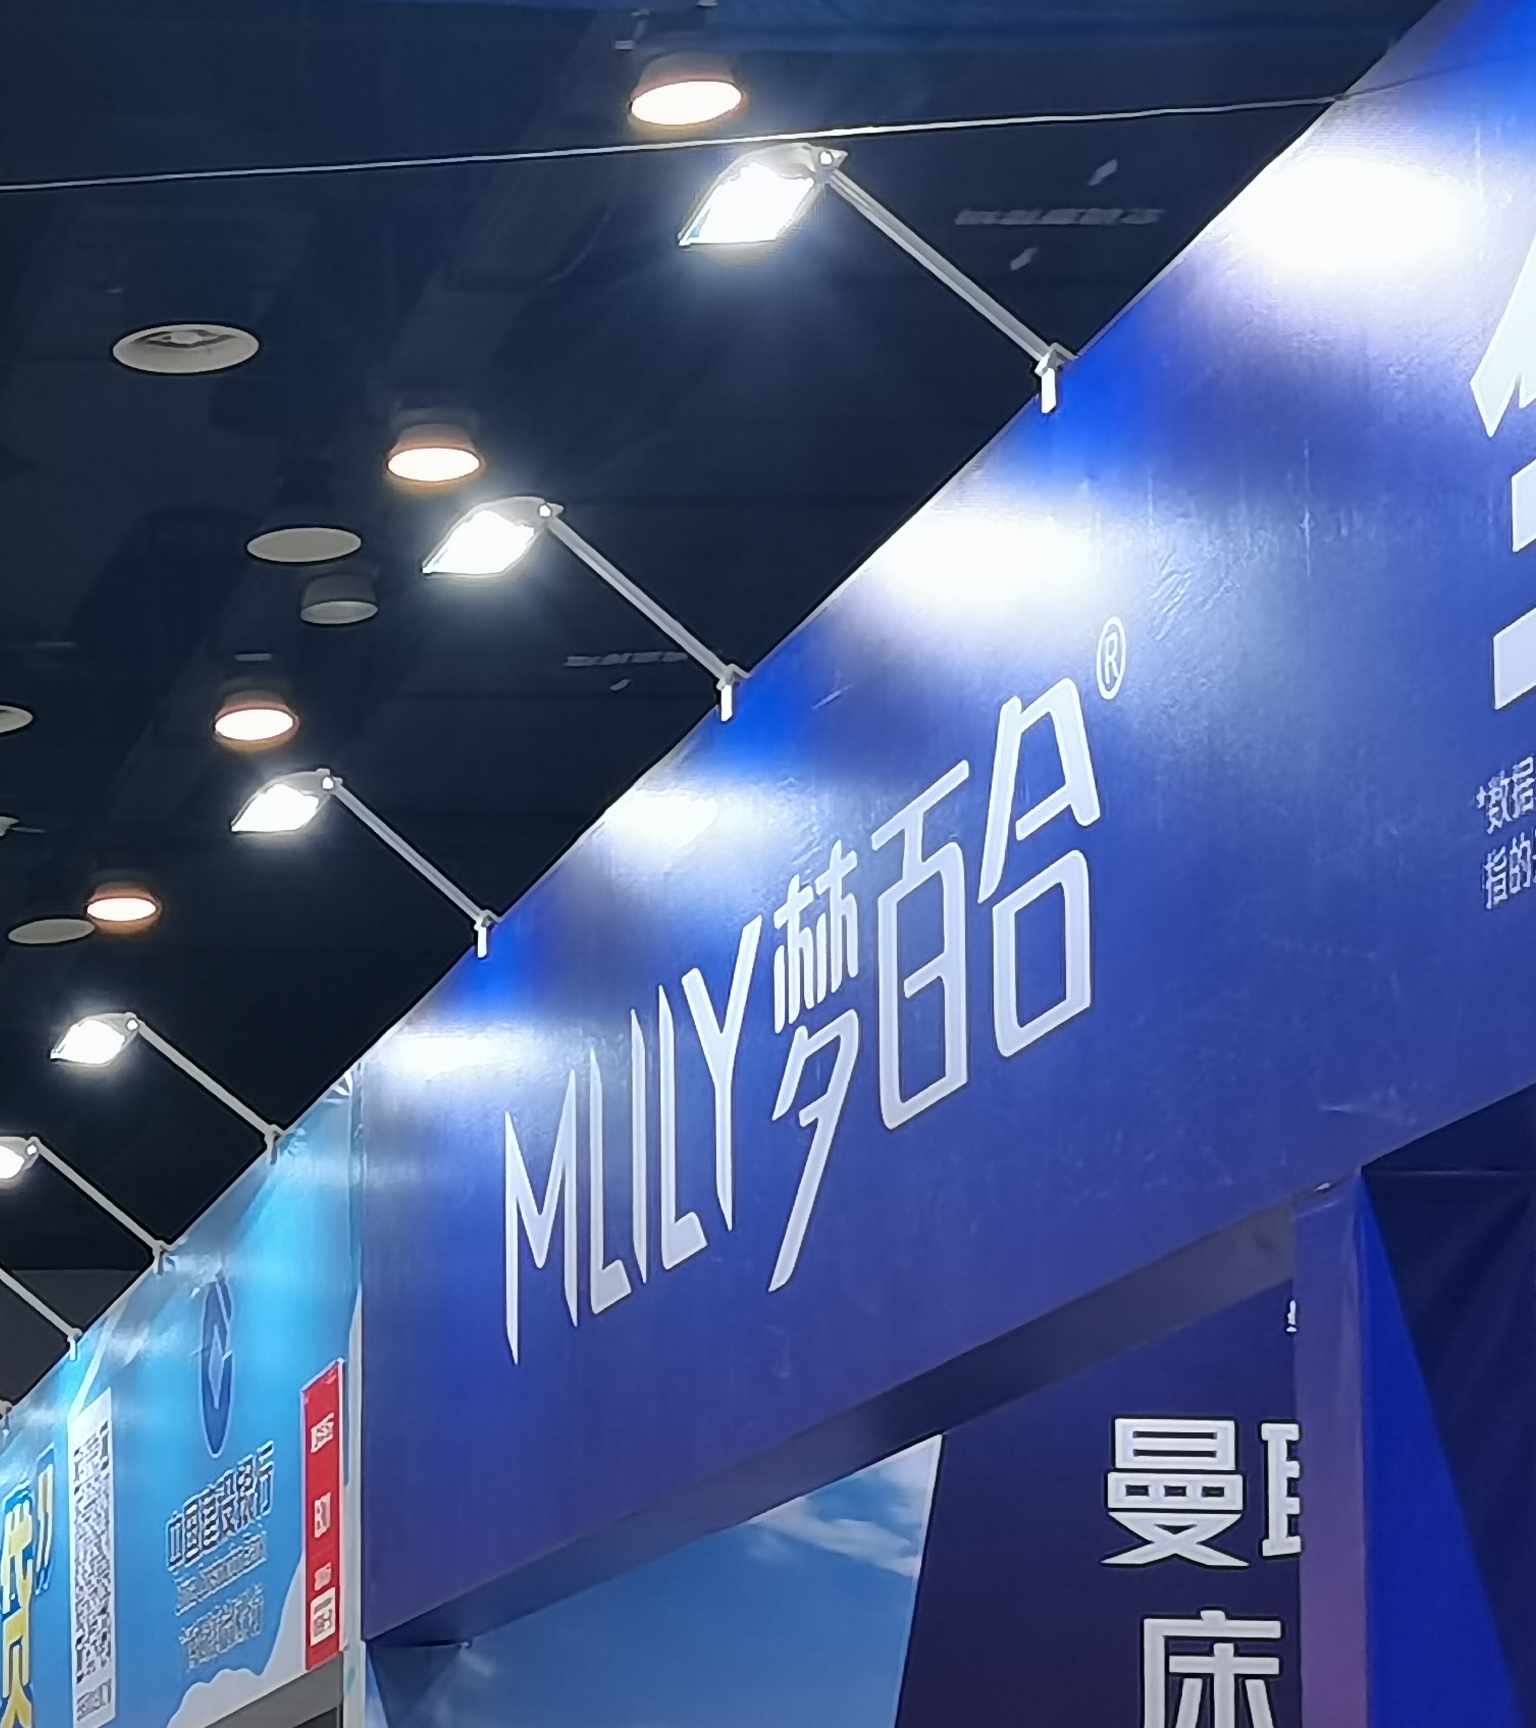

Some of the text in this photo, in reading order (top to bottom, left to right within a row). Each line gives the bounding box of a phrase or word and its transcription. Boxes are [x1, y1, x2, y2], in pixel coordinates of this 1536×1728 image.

[503, 914, 761, 1365] MLILY
[770, 676, 1102, 1293] 梦百合
